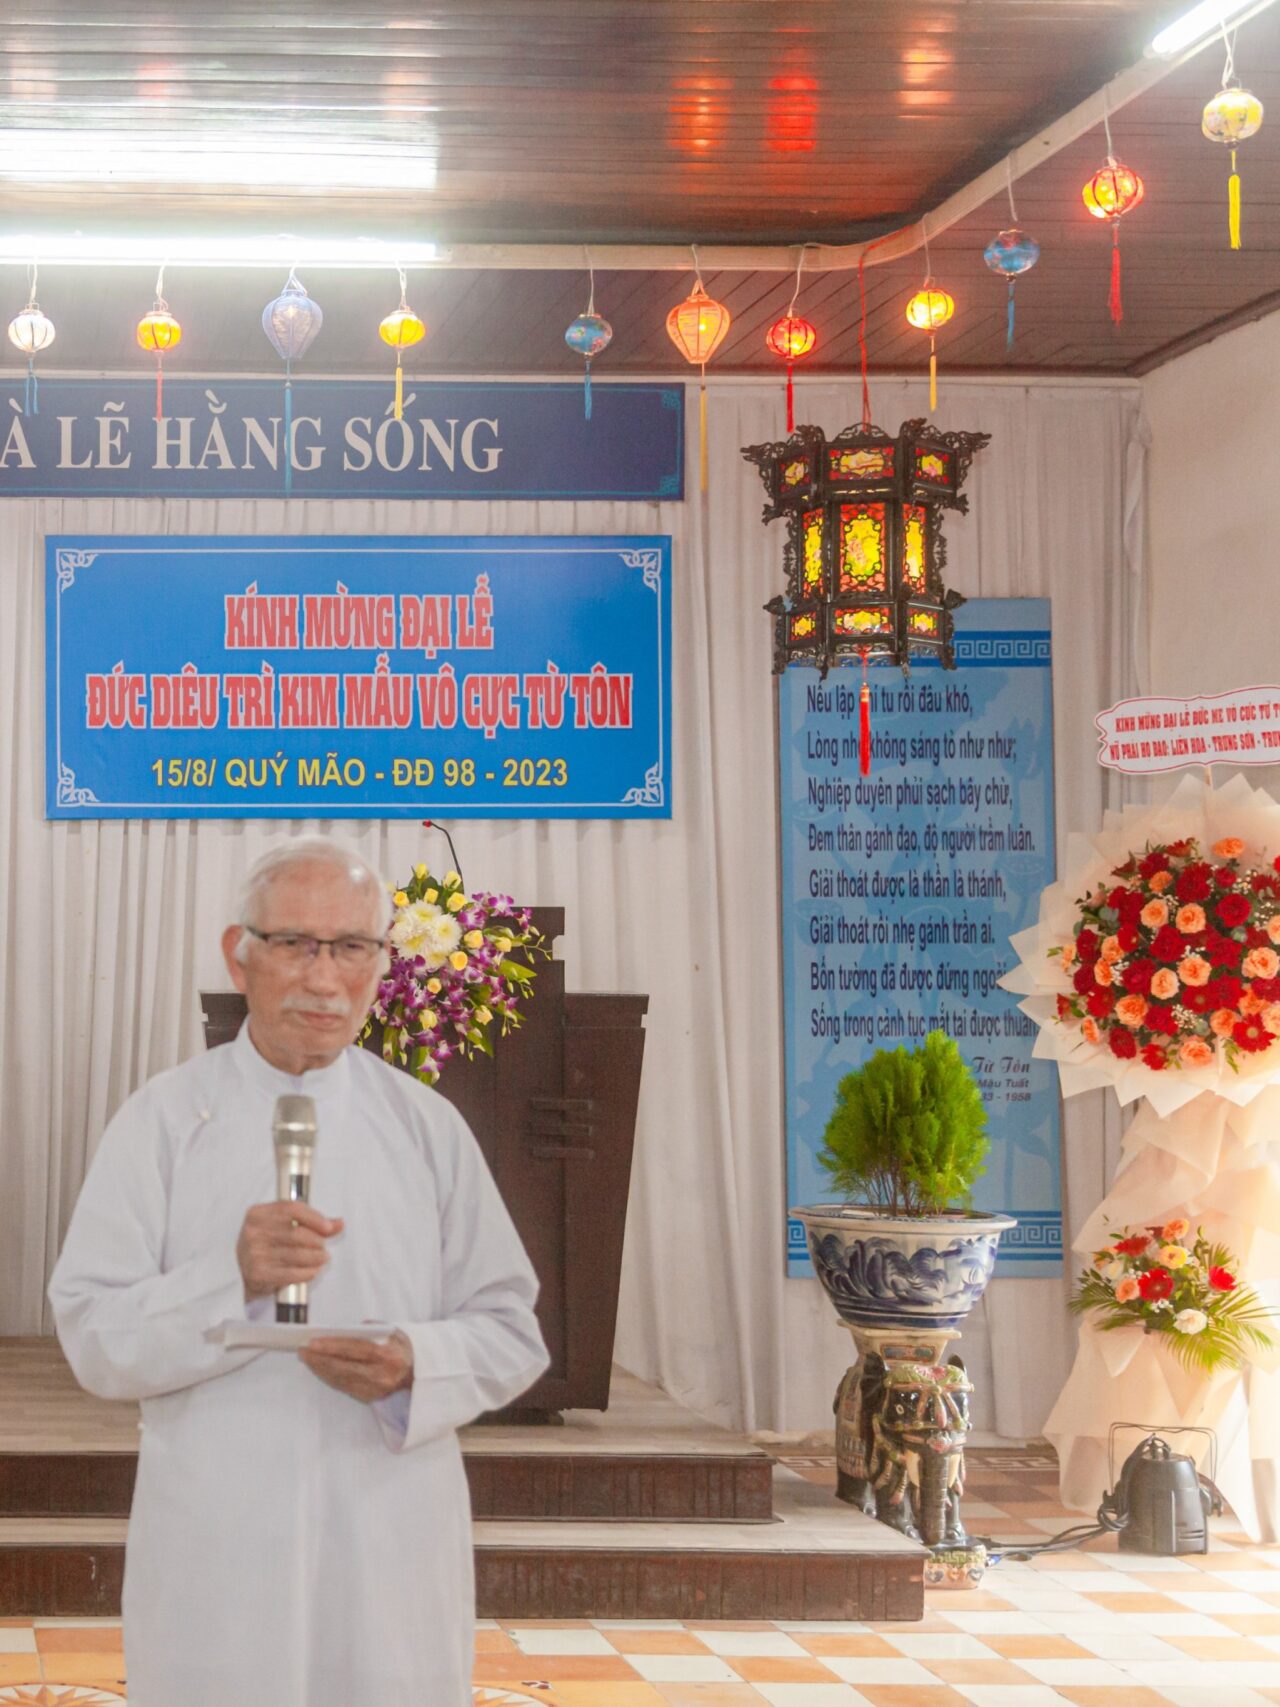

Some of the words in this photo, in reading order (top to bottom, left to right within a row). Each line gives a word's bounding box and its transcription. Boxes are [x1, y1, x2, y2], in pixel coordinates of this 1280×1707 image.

[56, 402, 131, 471] LẼ
[151, 390, 326, 473] HẰNG
[342, 392, 503, 474] SỐNG
[224, 580, 300, 650] KÍNH
[303, 580, 395, 650] MỪNG
[400, 594, 453, 659] ĐẠI
[456, 571, 494, 650] LỄ
[86, 659, 147, 729] ĐỨC
[150, 661, 220, 729] DIÊU
[223, 659, 275, 729] TRÌ
[278, 673, 340, 729] KIM
[343, 650, 414, 729] MẪU
[417, 661, 458, 729] VÔ
[462, 673, 520, 739] CỰC
[523, 659, 568, 729] TỪ
[570, 661, 633, 729] TÔN
[836, 684, 855, 719] lập
[881, 687, 894, 712] tu
[898, 680, 914, 712] rồi
[918, 684, 942, 712] đâu
[946, 683, 973, 717] khó,
[807, 730, 838, 766] Lòng
[869, 730, 907, 766] không
[910, 730, 940, 766] sáng
[959, 730, 984, 758] như
[152, 758, 214, 788] 15/8/
[225, 752, 288, 789] QUÝ
[297, 752, 365, 788] MÃO
[392, 758, 434, 787] ĐĐ
[443, 758, 476, 788] 98
[503, 758, 568, 788] 2023
[808, 776, 851, 812] Nghiệp
[855, 777, 892, 812] duyên
[896, 776, 923, 812] phủi
[927, 777, 956, 812] sạch
[808, 823, 834, 851] Đem
[837, 823, 862, 851] thân
[865, 823, 893, 859] gánh
[896, 824, 920, 858] đạo,
[923, 823, 938, 858] độ
[941, 822, 976, 858] người
[1008, 823, 1036, 851] luân.
[809, 869, 833, 898] Giải
[837, 869, 869, 897] thoát
[872, 869, 905, 904] được
[909, 869, 919, 897] là
[923, 863, 950, 897] thần
[953, 869, 964, 897] là
[968, 869, 1006, 902] thánh,
[810, 915, 834, 944] Giải
[837, 915, 869, 944] thoát
[873, 909, 888, 944] rồi
[893, 915, 915, 951] nhẹ
[919, 915, 949, 951] gánh
[952, 909, 977, 944] trần
[981, 915, 995, 944] ai.
[810, 956, 835, 990] Bốn
[839, 961, 877, 998] tường
[881, 962, 896, 990] đã
[899, 962, 932, 997] được
[936, 962, 969, 998] đứng
[811, 1002, 840, 1044] Sống
[843, 1010, 874, 1044] trong
[908, 1009, 926, 1044] tục
[953, 1009, 967, 1036] tai
[970, 1009, 1001, 1044] được
